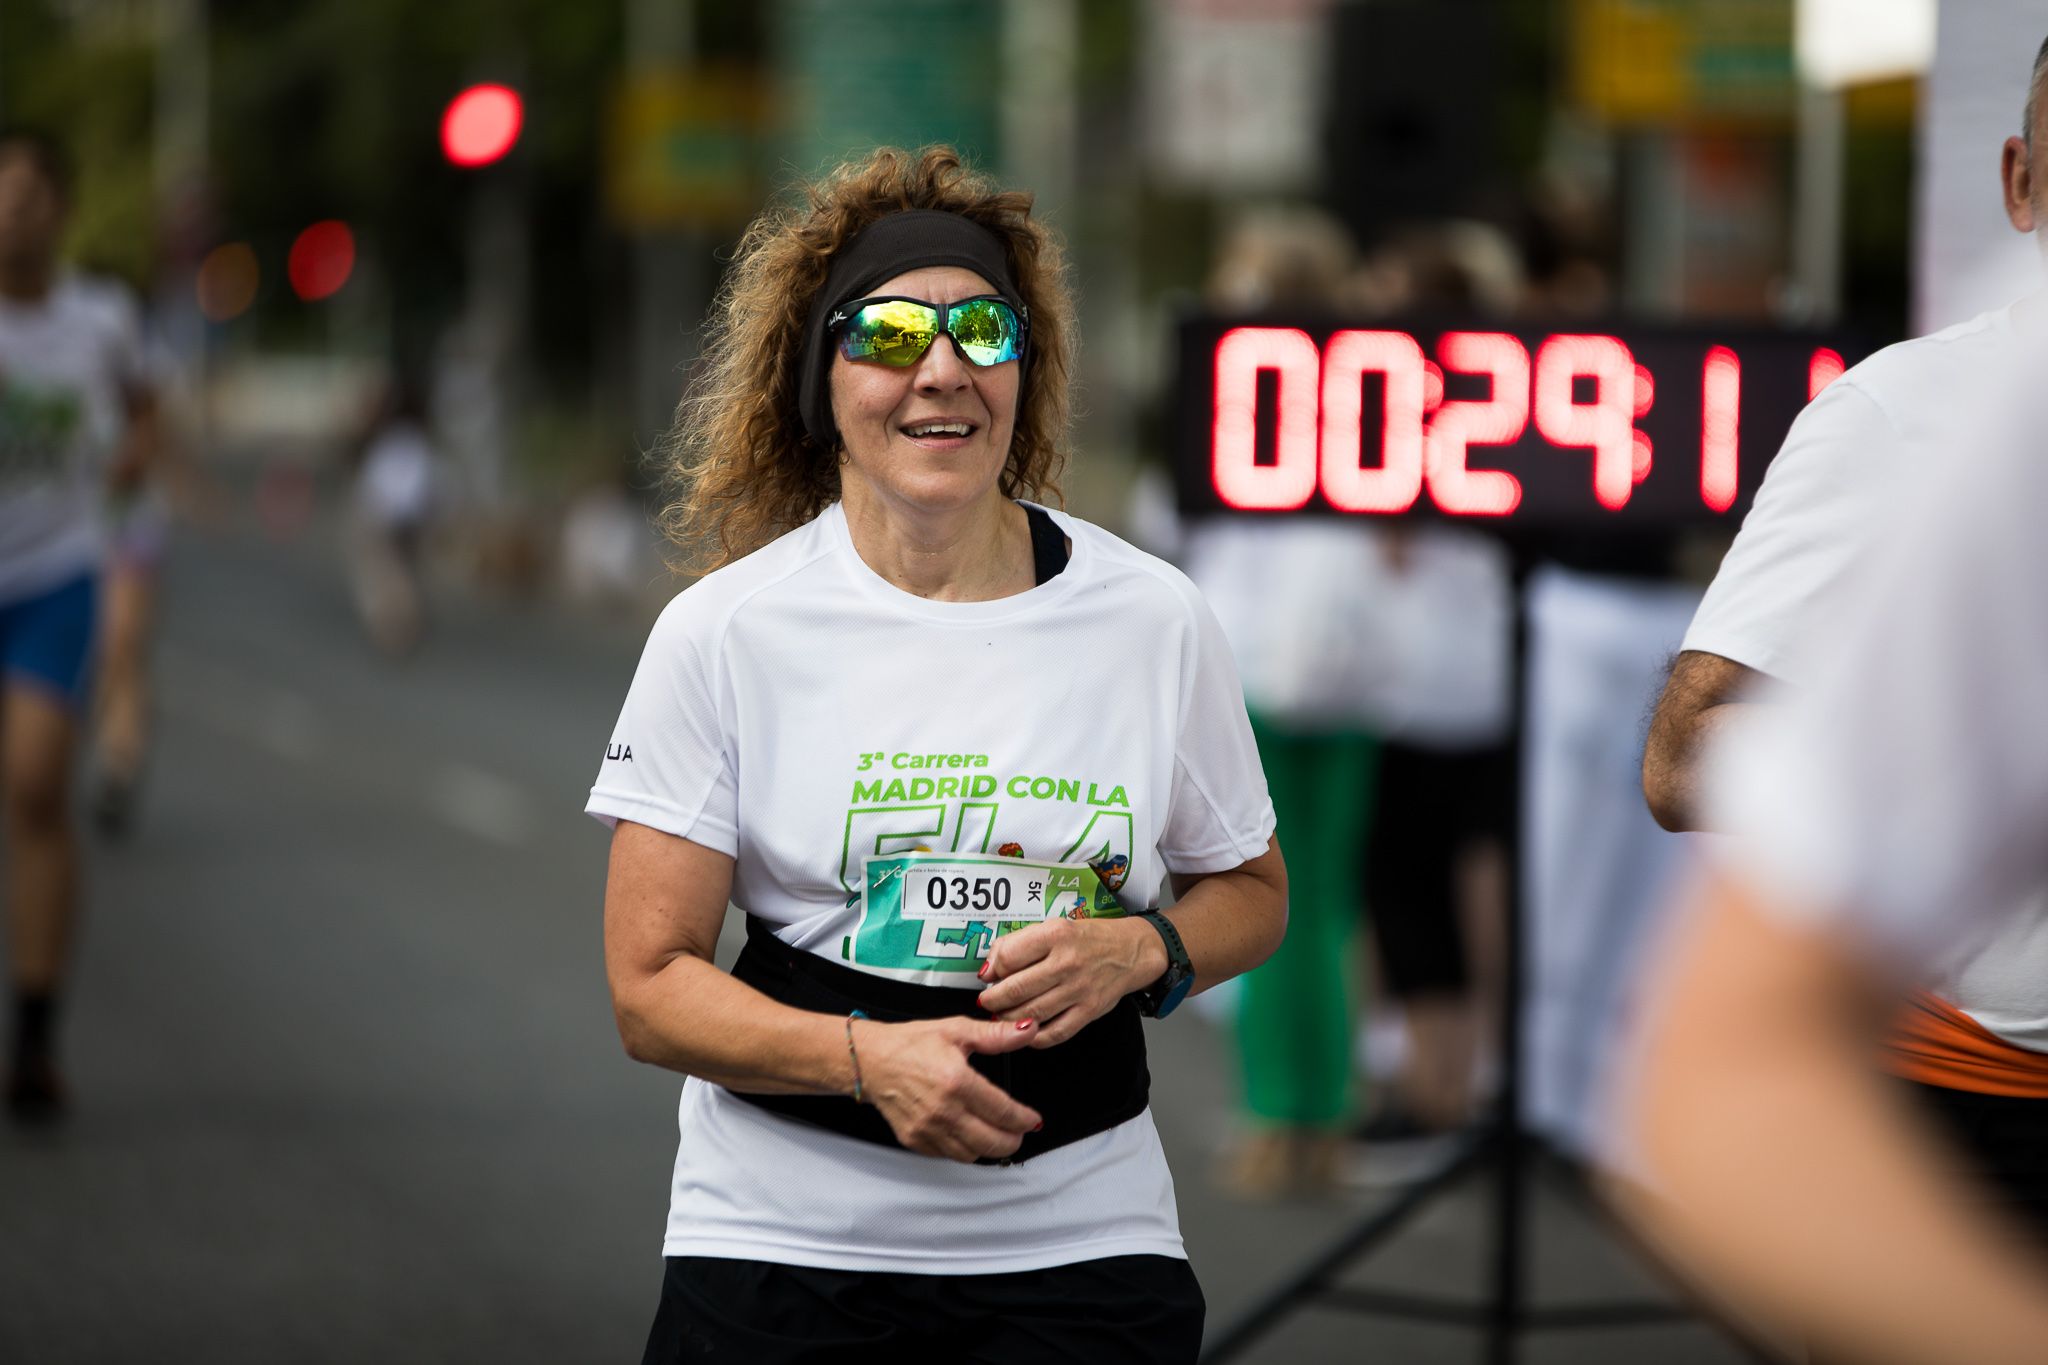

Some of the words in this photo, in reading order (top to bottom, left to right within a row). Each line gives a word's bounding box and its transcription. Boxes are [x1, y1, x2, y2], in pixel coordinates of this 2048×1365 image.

[891, 752, 989, 770] Carrera
[851, 775, 998, 804] MADRID
[1006, 775, 1081, 802] CON
[1086, 782, 1130, 808] LA
[1027, 880, 1043, 903] 5K
[1057, 875, 1080, 888] LA
[926, 876, 1012, 911] 0350
